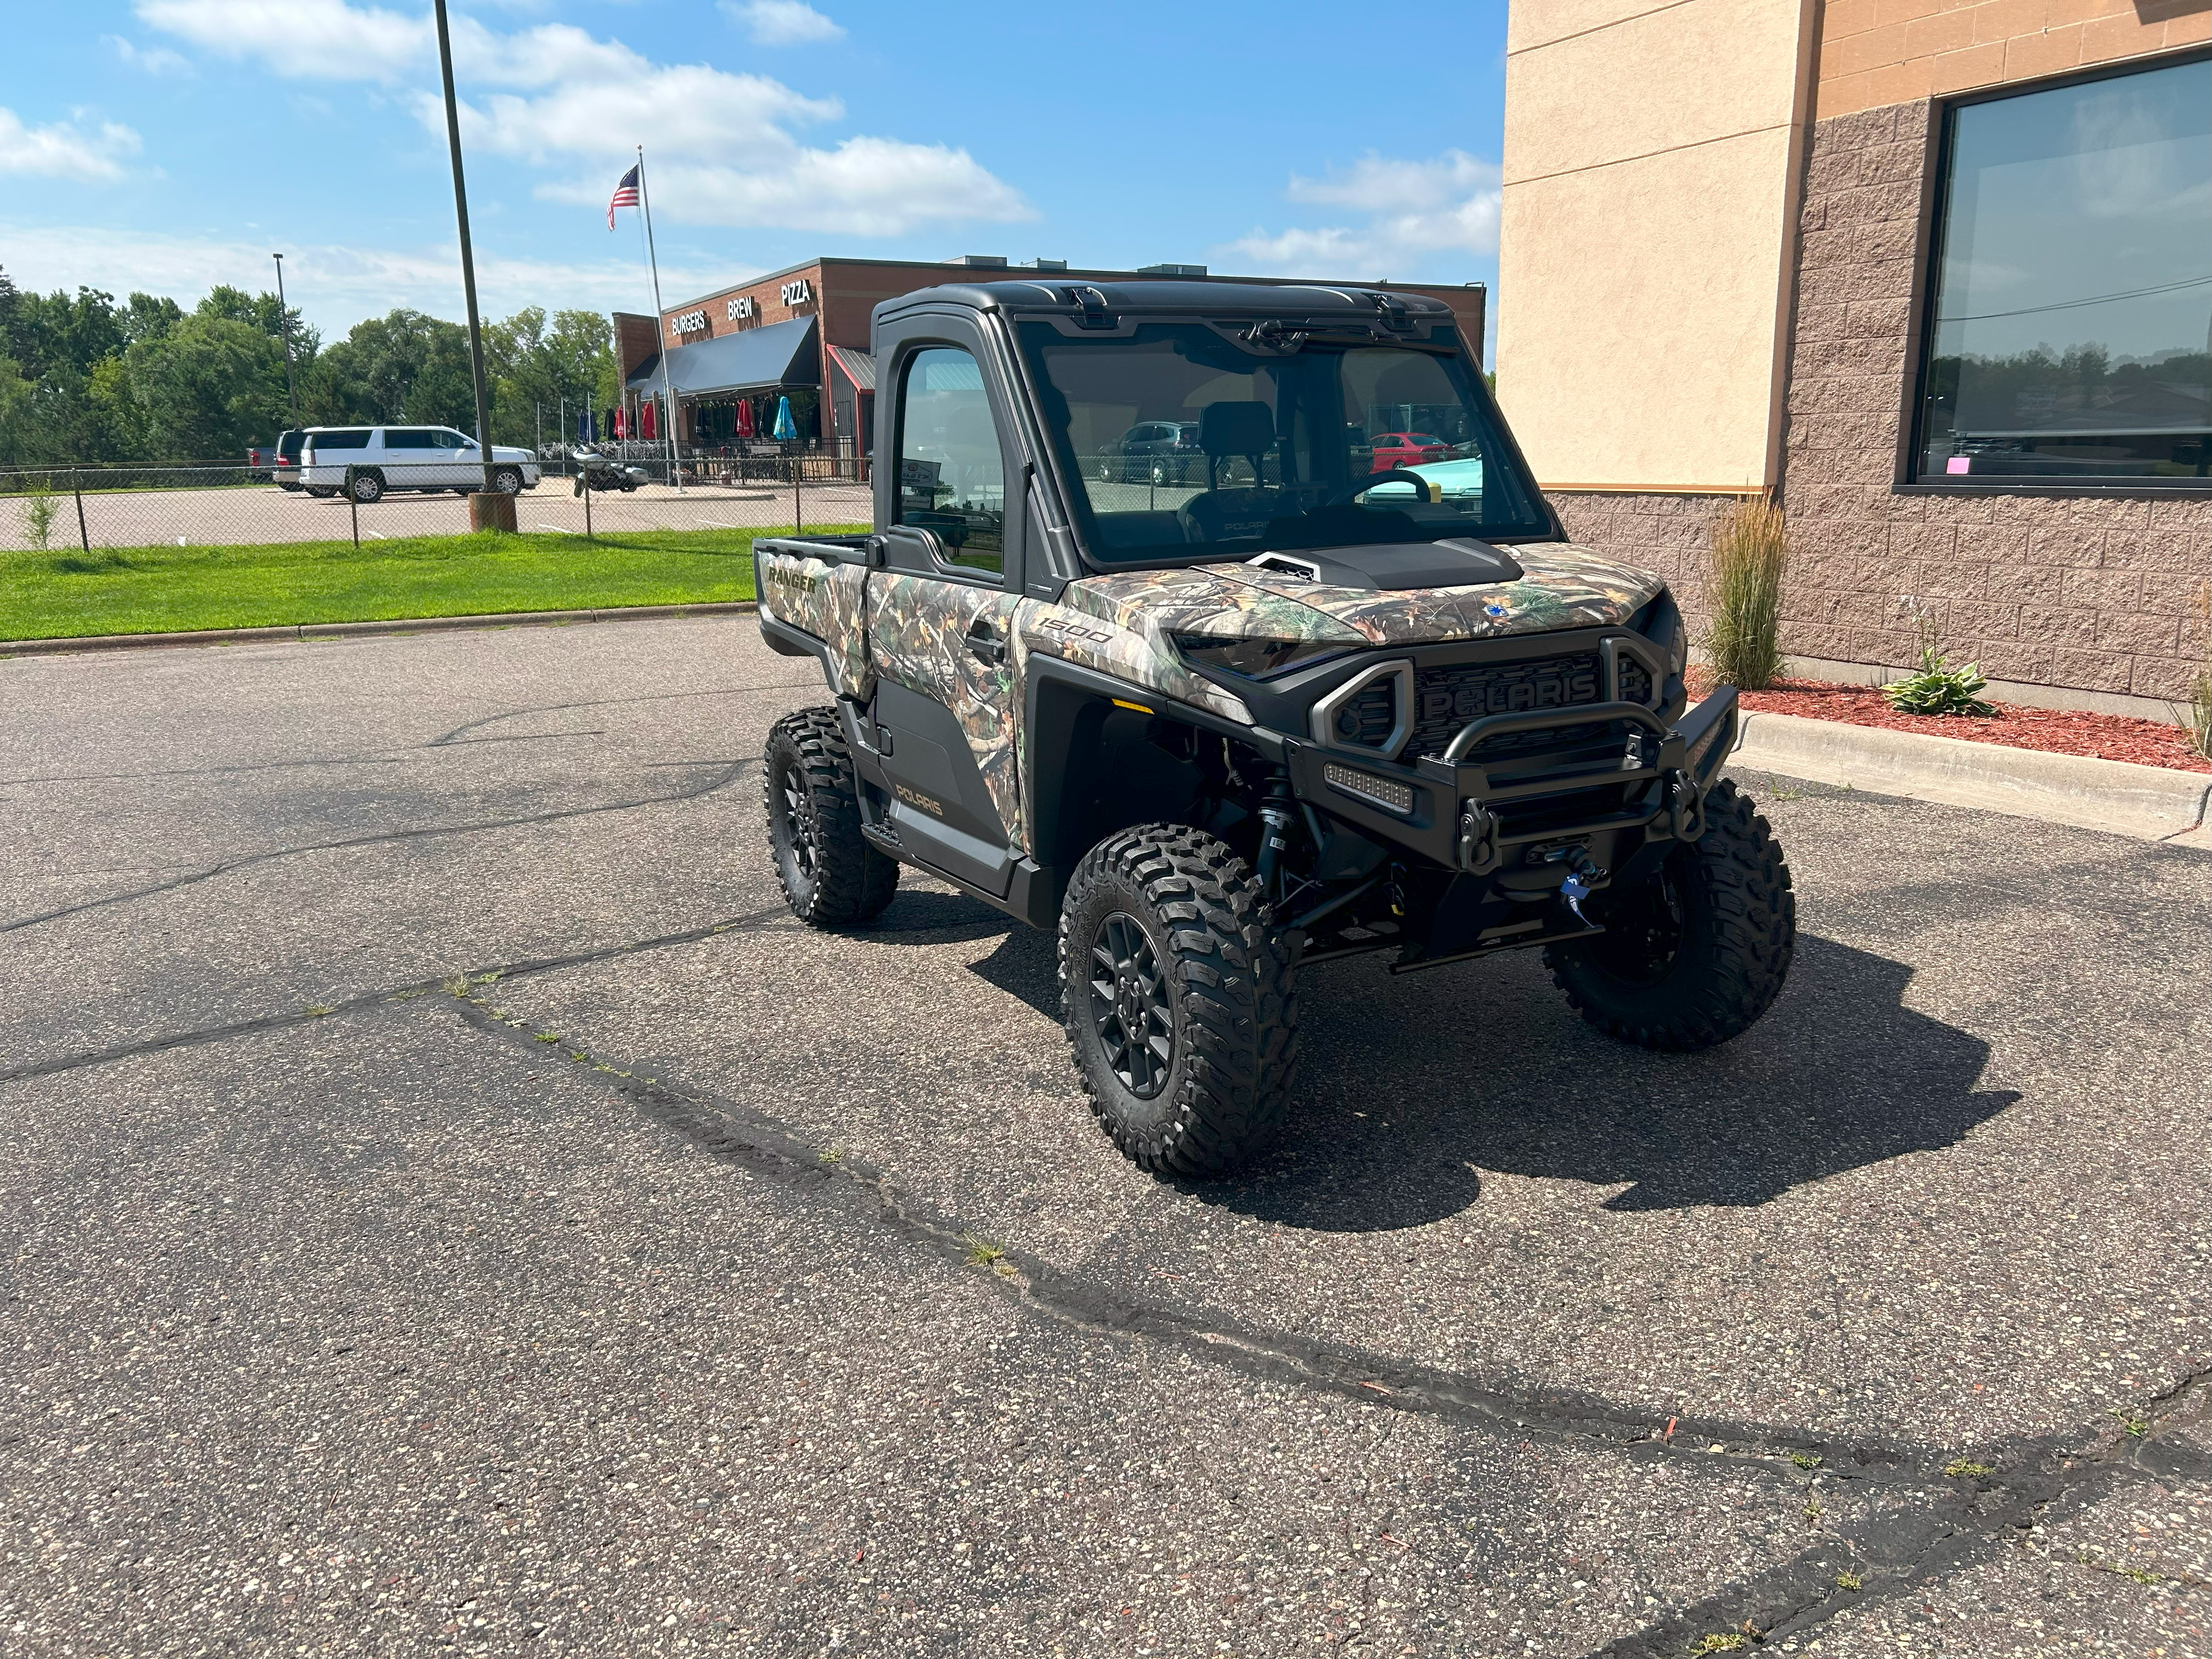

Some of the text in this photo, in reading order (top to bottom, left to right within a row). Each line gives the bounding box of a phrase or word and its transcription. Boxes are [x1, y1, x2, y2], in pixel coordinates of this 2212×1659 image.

[672, 279, 811, 336] BURGERS BREW PIZZA
[769, 566, 817, 594] RANGER
[1039, 617, 1114, 644] 1500
[1424, 674, 1596, 720] POLARIS
[895, 783, 943, 816] POLARIS
